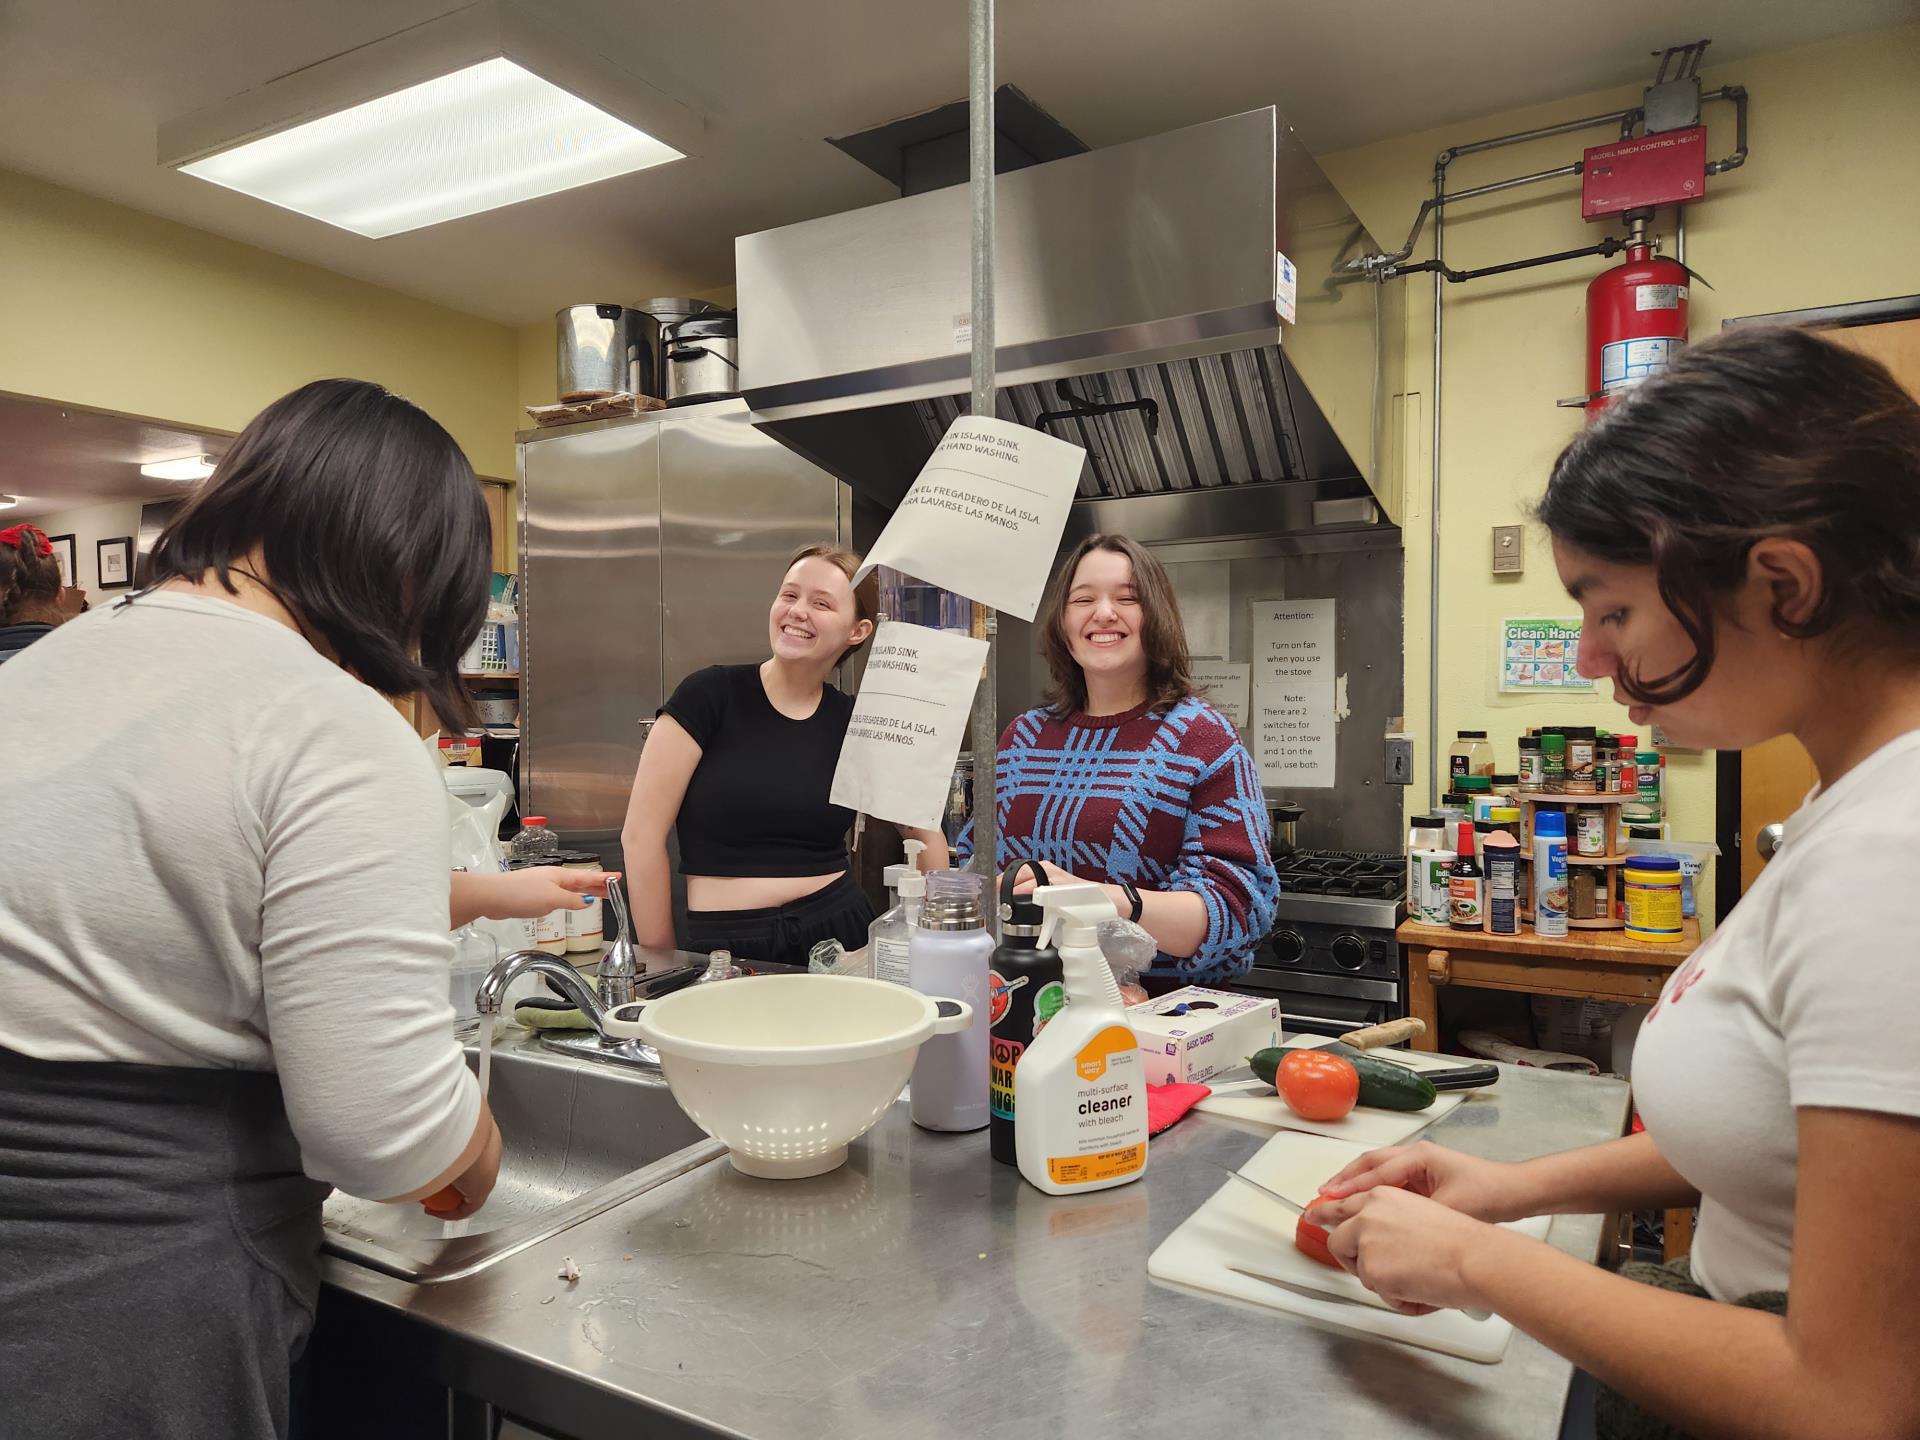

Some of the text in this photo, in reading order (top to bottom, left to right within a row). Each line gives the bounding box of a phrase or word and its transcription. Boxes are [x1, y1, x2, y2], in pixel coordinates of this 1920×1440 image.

[1590, 135, 1699, 161] MODEL NMCH CONTROL HEAD
[960, 432, 996, 443] ISLAND
[997, 438, 1021, 451] SINK.
[946, 443, 973, 451] HAND
[974, 446, 1021, 464] WASHING.
[934, 486, 990, 507] FREGADERO
[991, 501, 1003, 511] DE
[1005, 505, 1017, 517] LA
[1018, 510, 1041, 525] ISLA.
[921, 496, 963, 513] LAVARSE
[965, 506, 983, 519] LAS
[984, 512, 1020, 531] MANOS.
[1273, 612, 1314, 621] Attention:
[1507, 626, 1582, 640] Clean Hand
[1272, 642, 1290, 650] Turn
[1303, 641, 1317, 649] fan
[897, 647, 920, 659] SINK.
[1267, 654, 1289, 663] when
[1290, 656, 1305, 664] you
[882, 660, 919, 673] WASHING.
[1275, 668, 1312, 676] the stove
[1264, 708, 1286, 716] There
[889, 719, 900, 727] DE
[901, 720, 912, 731] LA
[914, 723, 938, 737] ISLA.
[1263, 721, 1310, 729] switches for
[884, 732, 915, 746] MANOS.
[1263, 734, 1279, 743] fan,
[1264, 747, 1279, 755] and
[1264, 761, 1283, 769] wall,
[1299, 761, 1319, 769] both
[991, 1066, 1012, 1088] WAR
[1077, 1083, 1129, 1098] multi-surface
[1078, 1094, 1133, 1115] cleaner
[1078, 1114, 1124, 1128] with bleach
